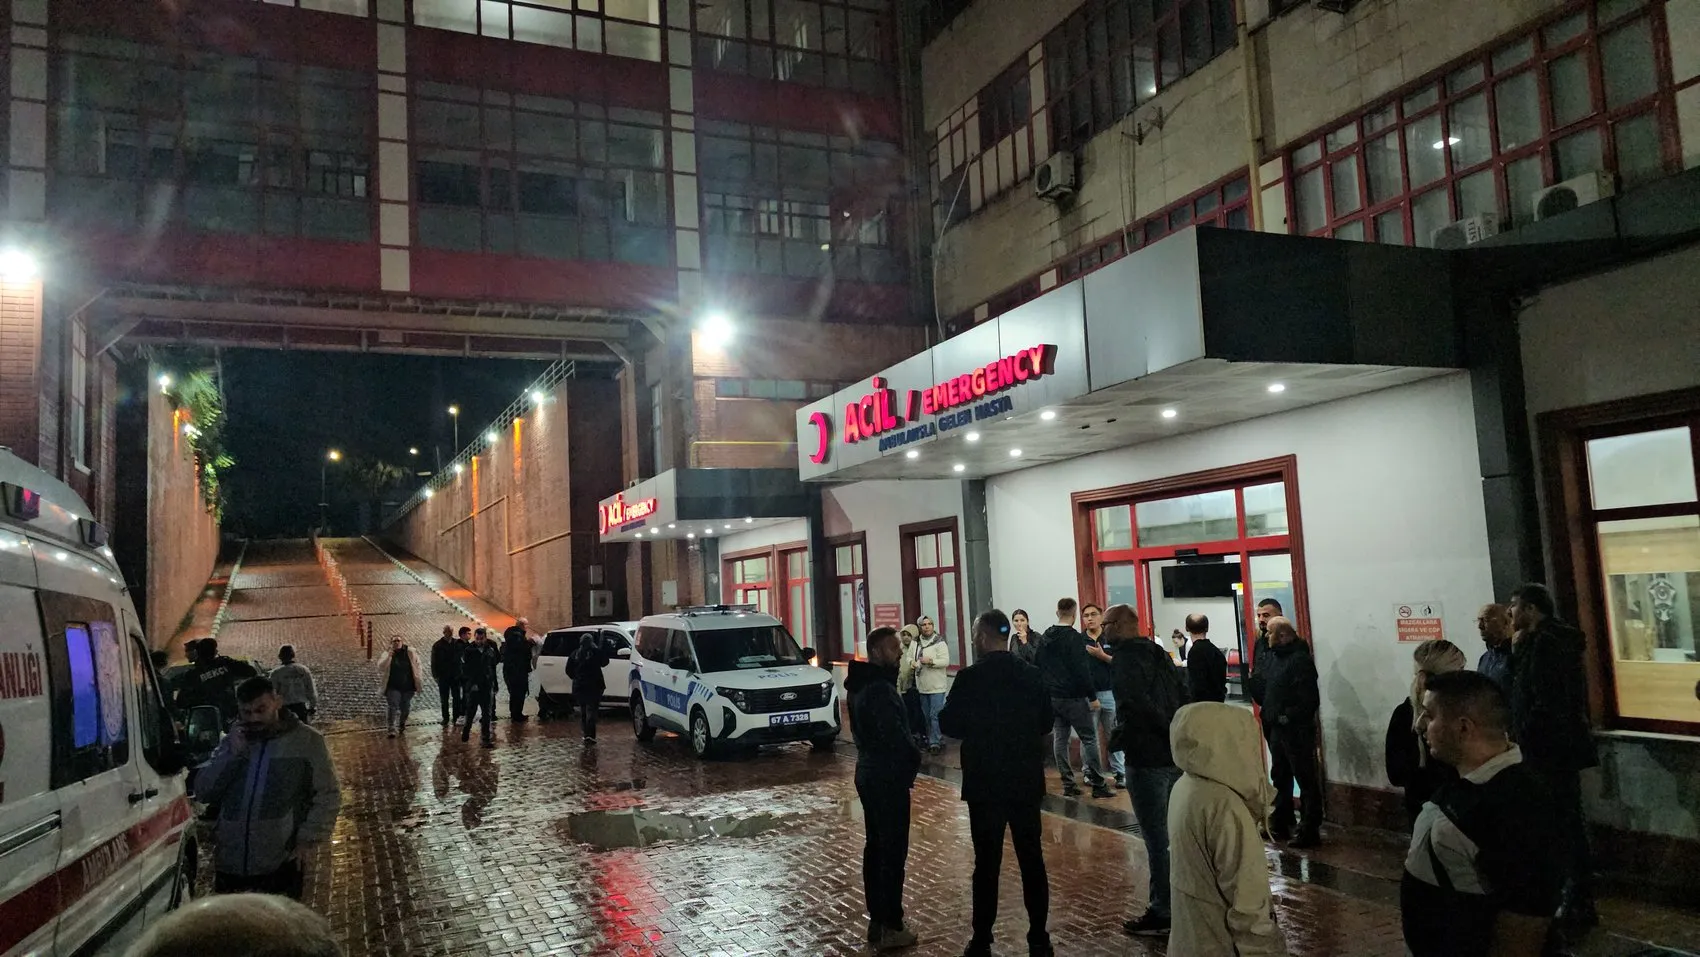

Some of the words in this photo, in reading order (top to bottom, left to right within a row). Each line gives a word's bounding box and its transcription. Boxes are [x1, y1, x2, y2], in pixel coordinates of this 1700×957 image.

[843, 376, 900, 444] ACİL
[922, 344, 1057, 415] EMERGENCY
[938, 408, 973, 432] GELEN
[974, 395, 1013, 421] HASTA
[783, 715, 789, 723] A
